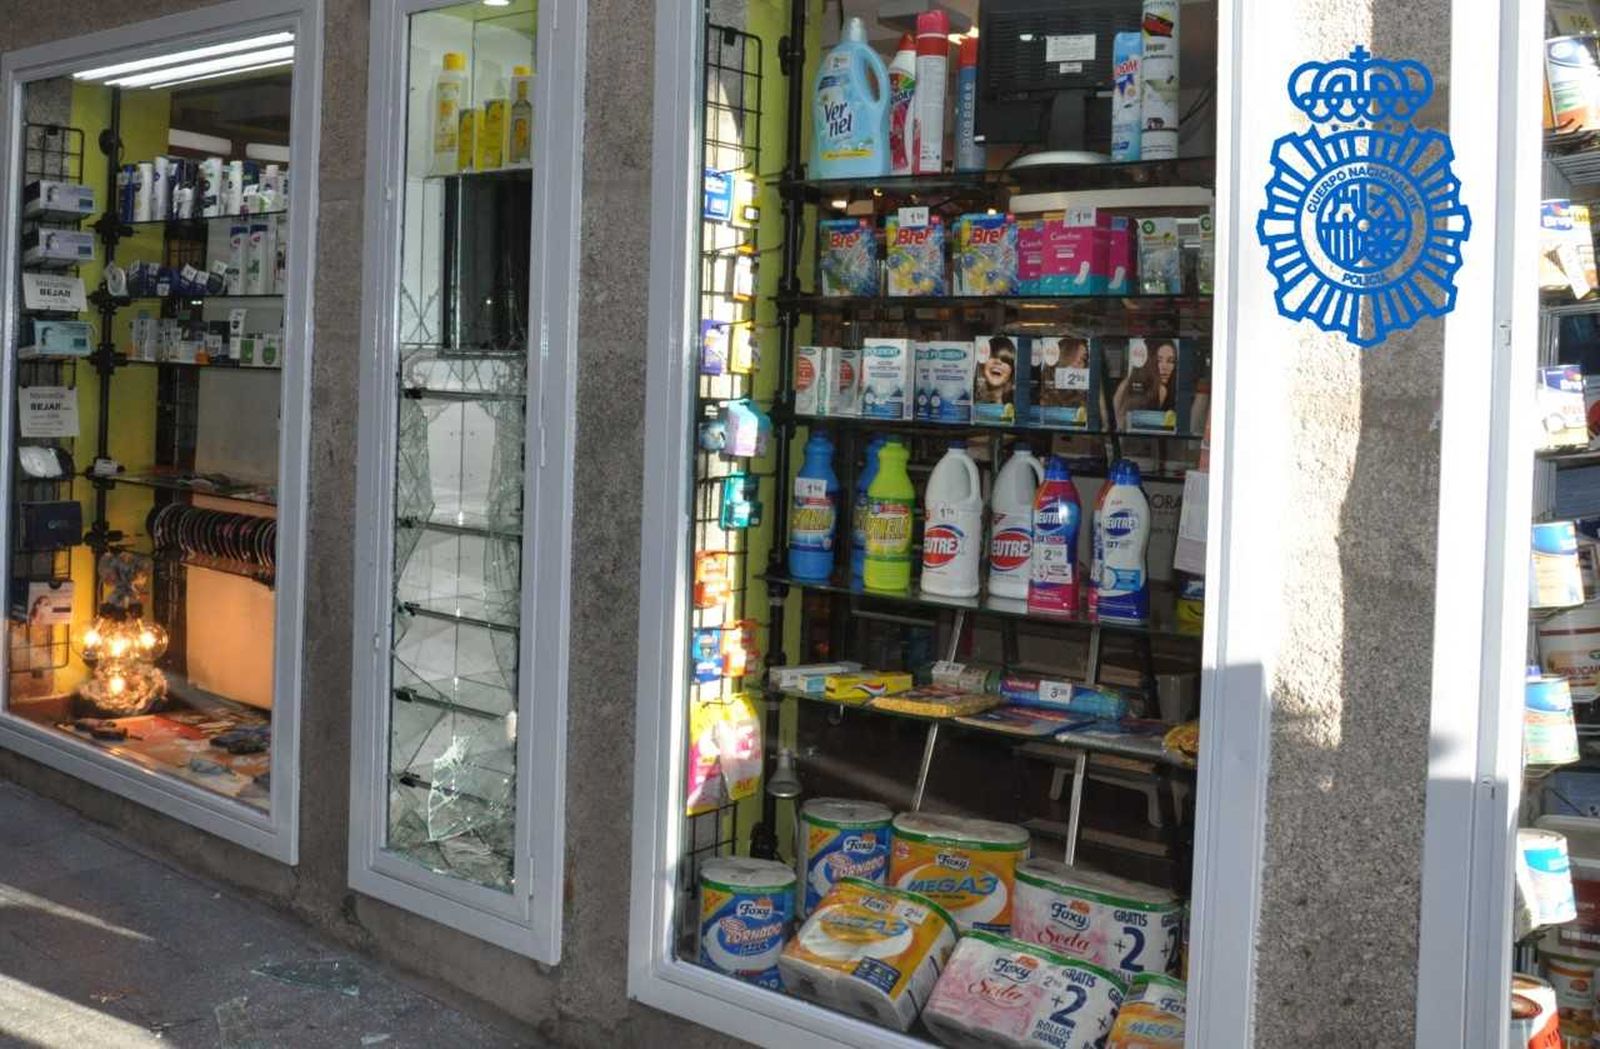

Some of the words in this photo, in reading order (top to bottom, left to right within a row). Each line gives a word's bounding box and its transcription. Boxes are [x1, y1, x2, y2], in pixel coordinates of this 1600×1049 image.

[824, 101, 848, 122] Ver
[829, 112, 852, 137] nel
[830, 230, 860, 249] Bref
[896, 227, 934, 246] Bref
[970, 226, 1005, 245] Bref
[740, 903, 770, 918] Foxy
[1051, 901, 1088, 927] Foxy
[1113, 909, 1149, 927] GRATIS
[994, 957, 1032, 979] Foxy
[1061, 968, 1097, 988] GRATIS
[1161, 997, 1186, 1014] Fox
[1036, 1019, 1073, 1040] ROLLOS
